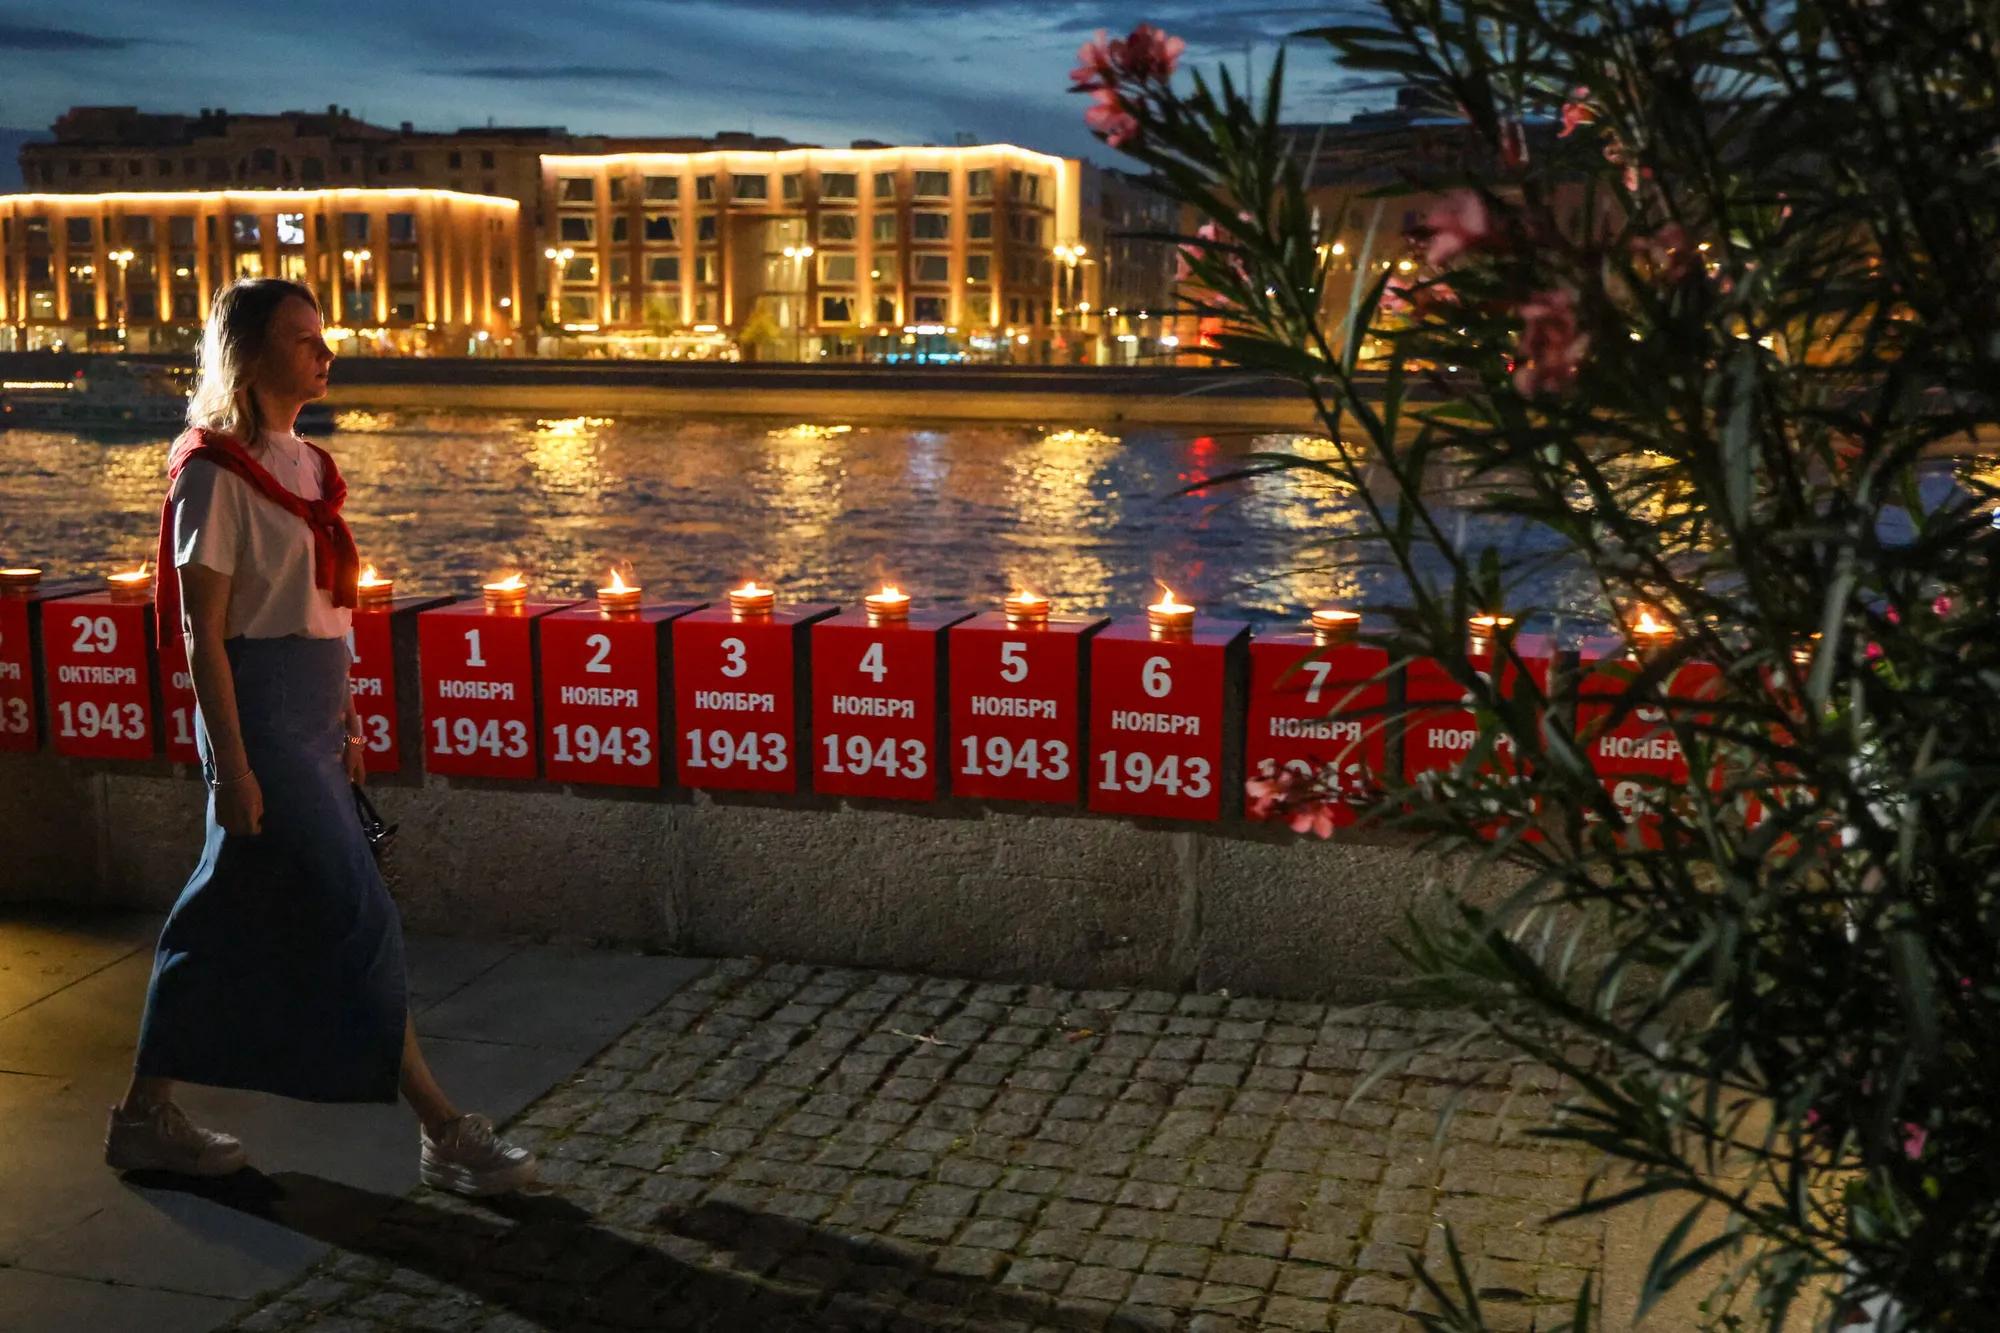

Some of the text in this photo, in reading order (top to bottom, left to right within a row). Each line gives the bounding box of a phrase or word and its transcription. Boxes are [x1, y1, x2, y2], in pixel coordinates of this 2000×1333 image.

[71, 615, 118, 654] 29
[464, 628, 486, 667] 1
[585, 633, 612, 673] 2
[58, 665, 137, 685] ОКТЯБРЯ
[720, 637, 747, 678] 3
[859, 642, 888, 683] 4
[999, 641, 1029, 683] 5
[1141, 655, 1172, 698] 6
[439, 679, 514, 701] НОЯБРЯ
[561, 685, 639, 708] НОЯБРЯ
[695, 690, 775, 713] НОЯБРЯ
[1303, 661, 1332, 703] 7
[58, 701, 145, 740] 1943
[832, 695, 915, 719] НОЯБРЯ
[971, 695, 1057, 719] НОЯБРЯ
[1111, 710, 1200, 736] НОЯБРЯ
[432, 716, 529, 758] 1943
[553, 723, 652, 766] 1943
[1269, 716, 1362, 744] НОЯБРЯ
[1599, 736, 1685, 761] НОЯБР
[686, 728, 788, 773] 1943
[822, 733, 927, 780] 1943
[961, 735, 1070, 781] 1943
[1098, 750, 1212, 799] 1943
